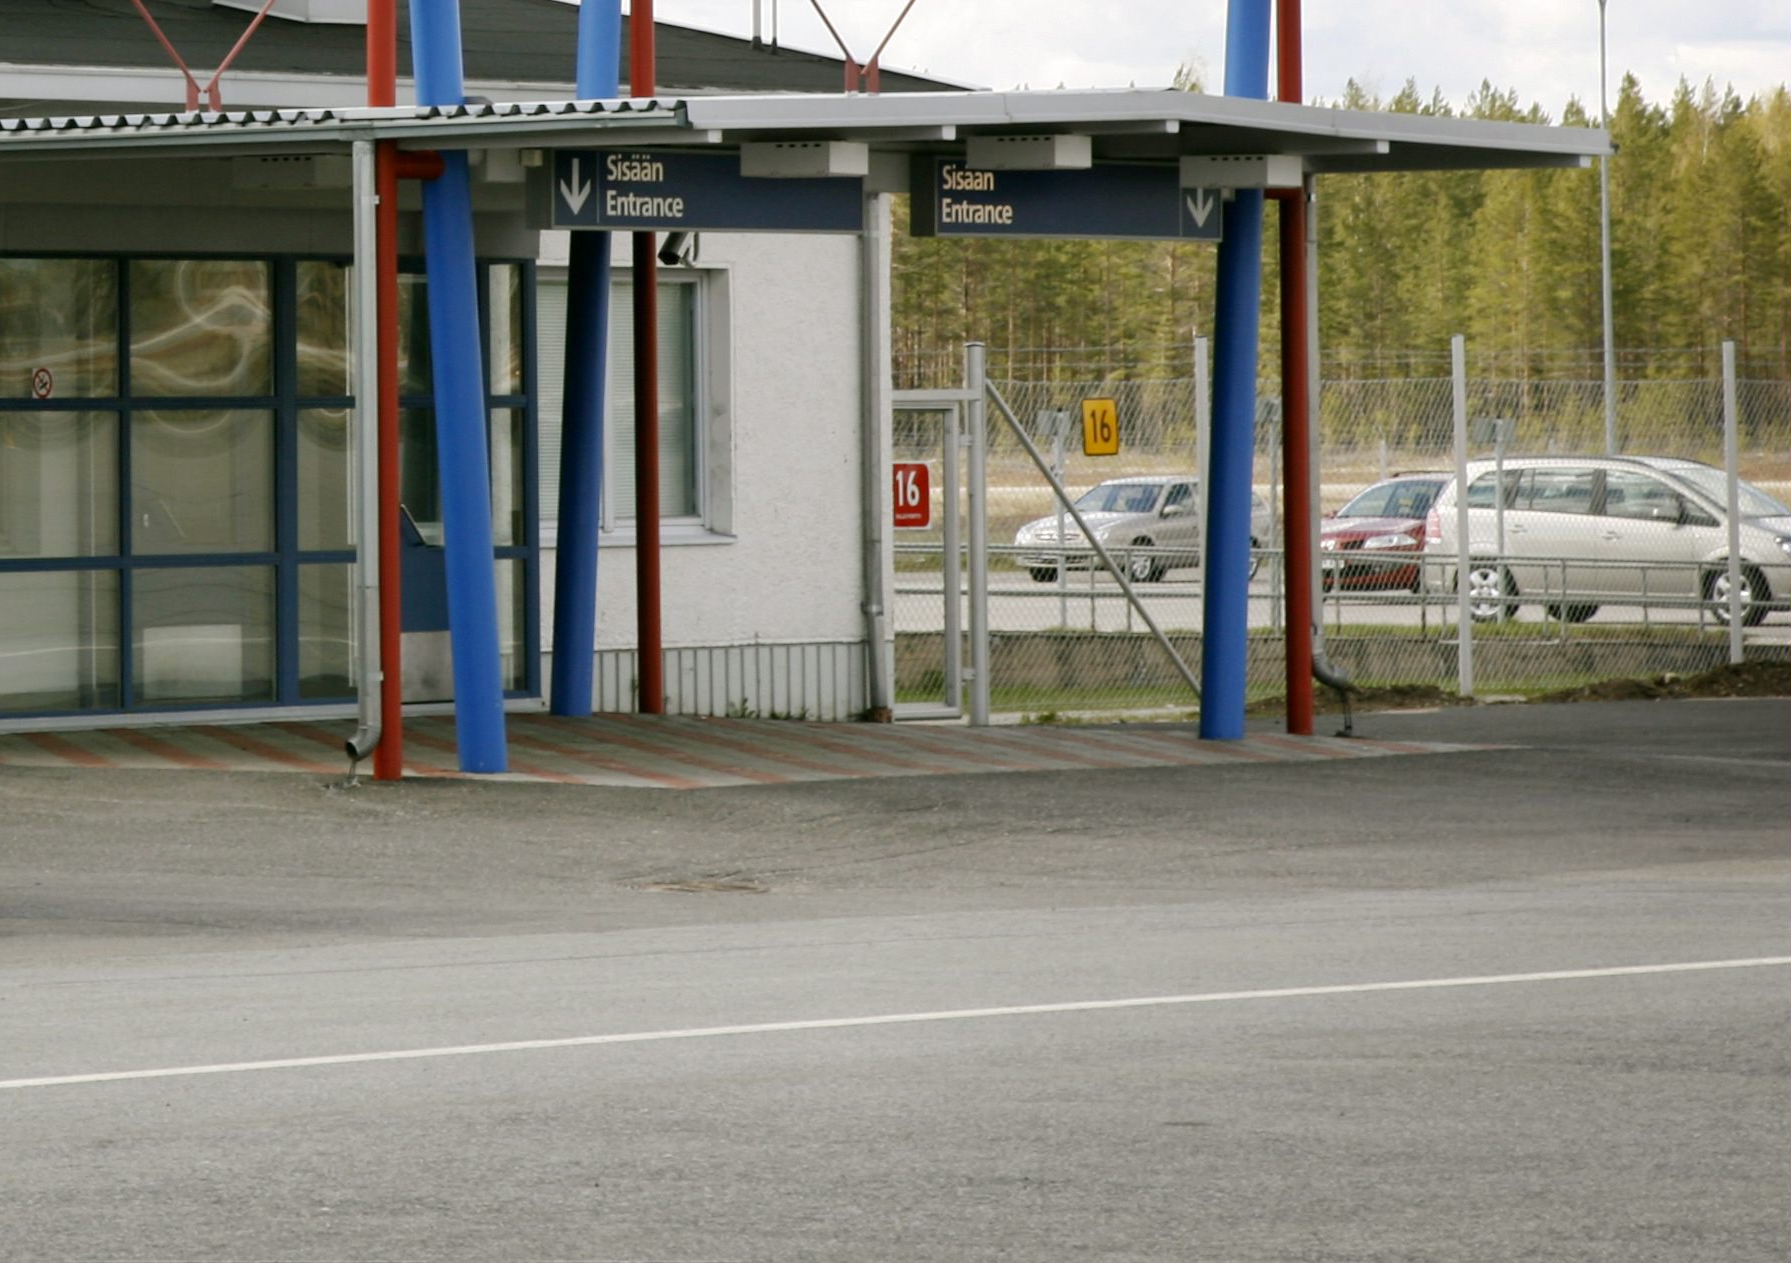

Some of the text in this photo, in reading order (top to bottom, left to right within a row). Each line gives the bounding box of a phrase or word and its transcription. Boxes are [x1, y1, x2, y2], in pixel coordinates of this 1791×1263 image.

[606, 153, 664, 182] Sisään
[606, 189, 684, 218] Entrance
[941, 197, 1013, 224] Entrance
[1090, 409, 1112, 444] 16
[896, 469, 920, 507] 16
